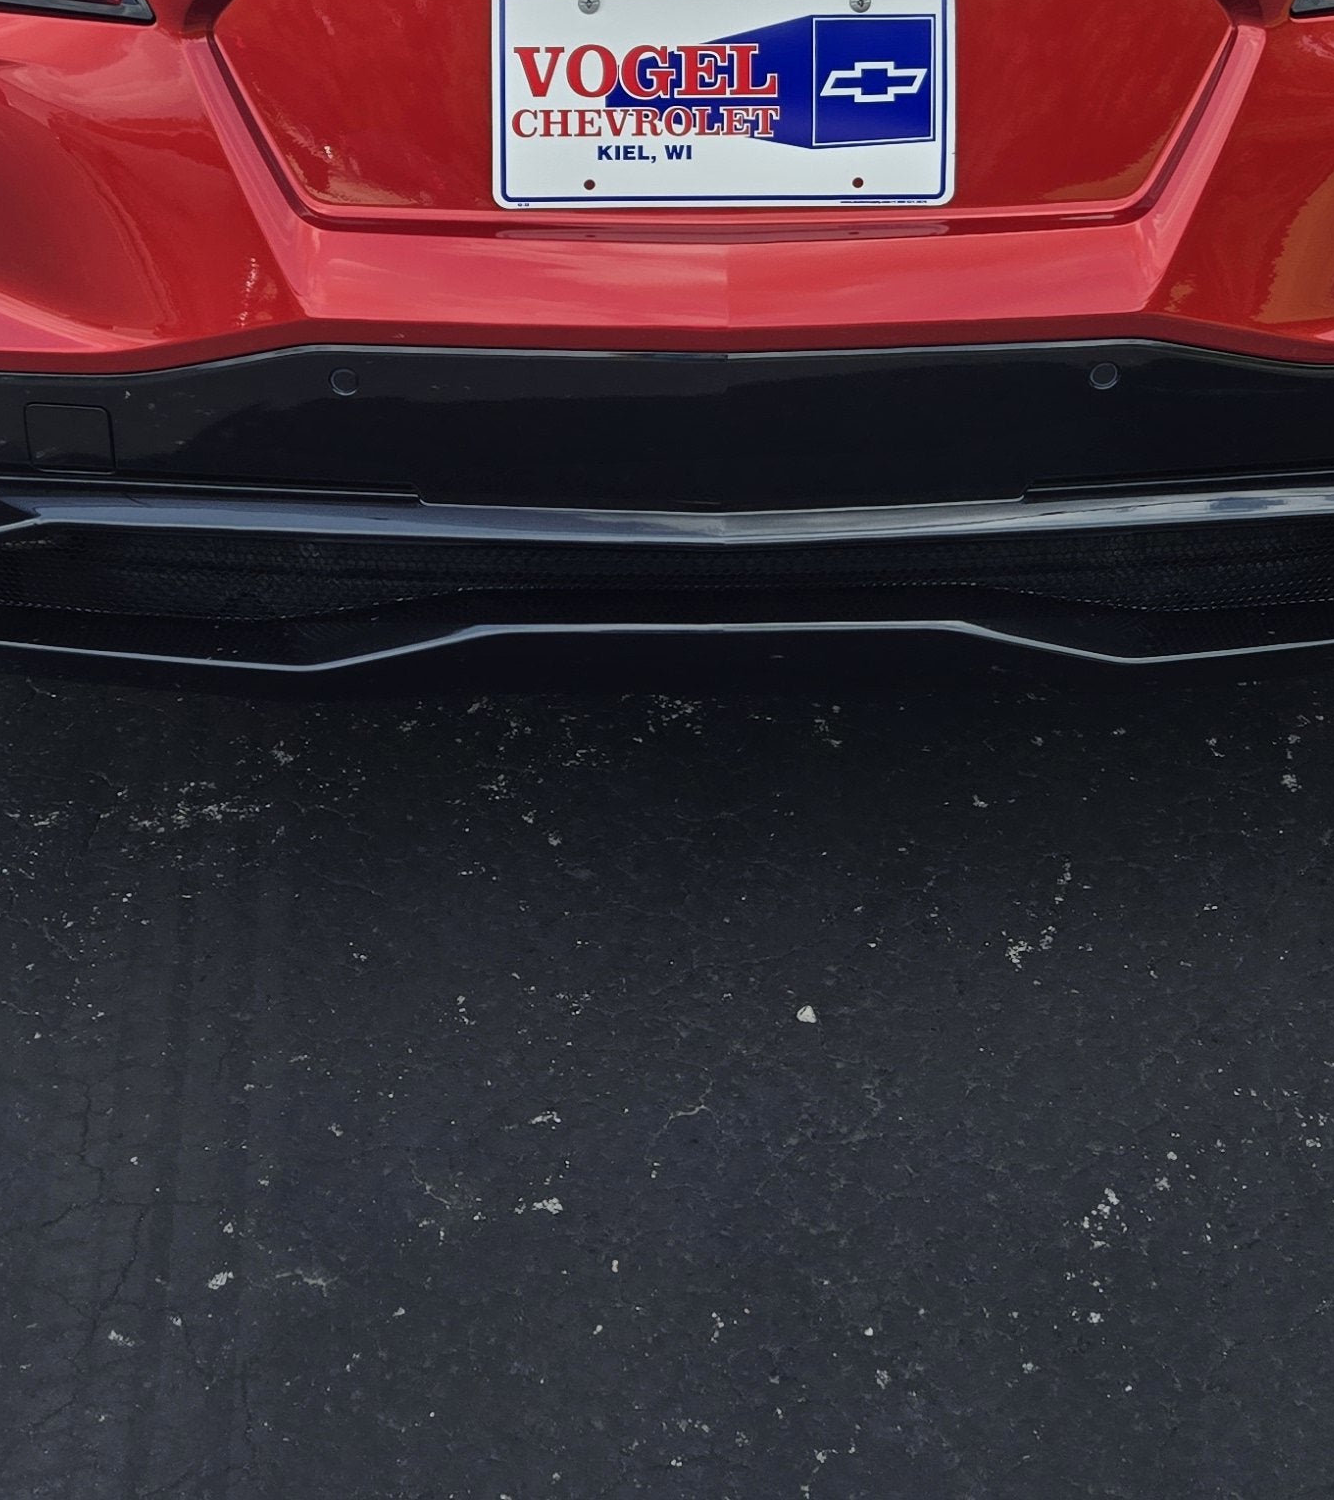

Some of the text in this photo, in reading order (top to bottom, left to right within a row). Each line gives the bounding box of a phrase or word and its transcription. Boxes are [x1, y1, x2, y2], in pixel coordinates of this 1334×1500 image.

[514, 43, 778, 99] VOGEL
[511, 106, 780, 138] CHEVROLET
[597, 144, 692, 164] KIEL, WI
